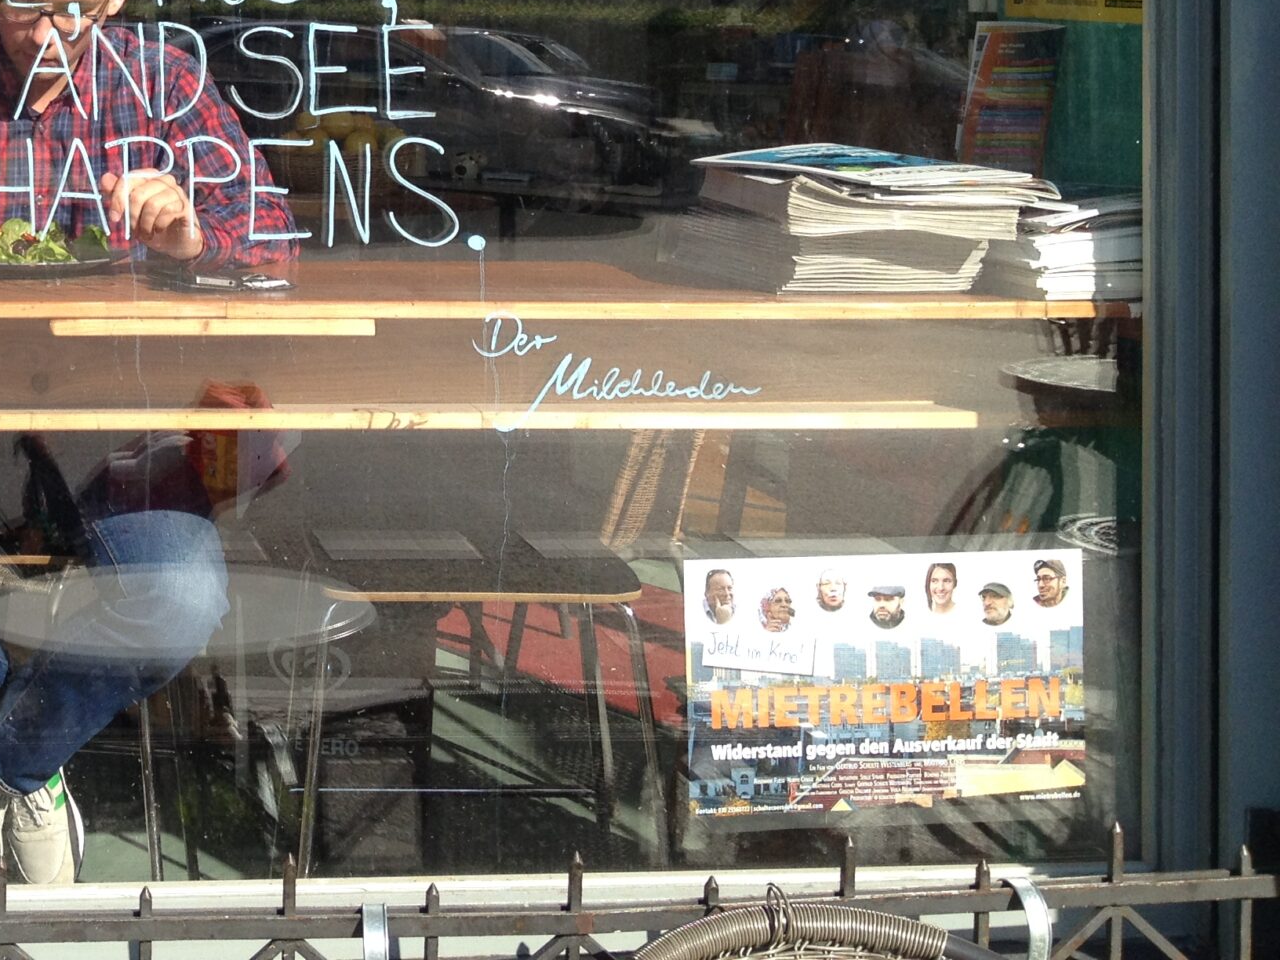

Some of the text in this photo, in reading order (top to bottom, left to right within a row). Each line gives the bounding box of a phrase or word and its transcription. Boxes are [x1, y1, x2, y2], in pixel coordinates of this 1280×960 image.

[14, 21, 207, 122] AND
[229, 22, 437, 121] SEE
[472, 310, 558, 358] Der
[711, 676, 1061, 730] MIETREBELLEN
[711, 730, 1059, 761] Widerstand gegen den Ausverkauf der Stadt
